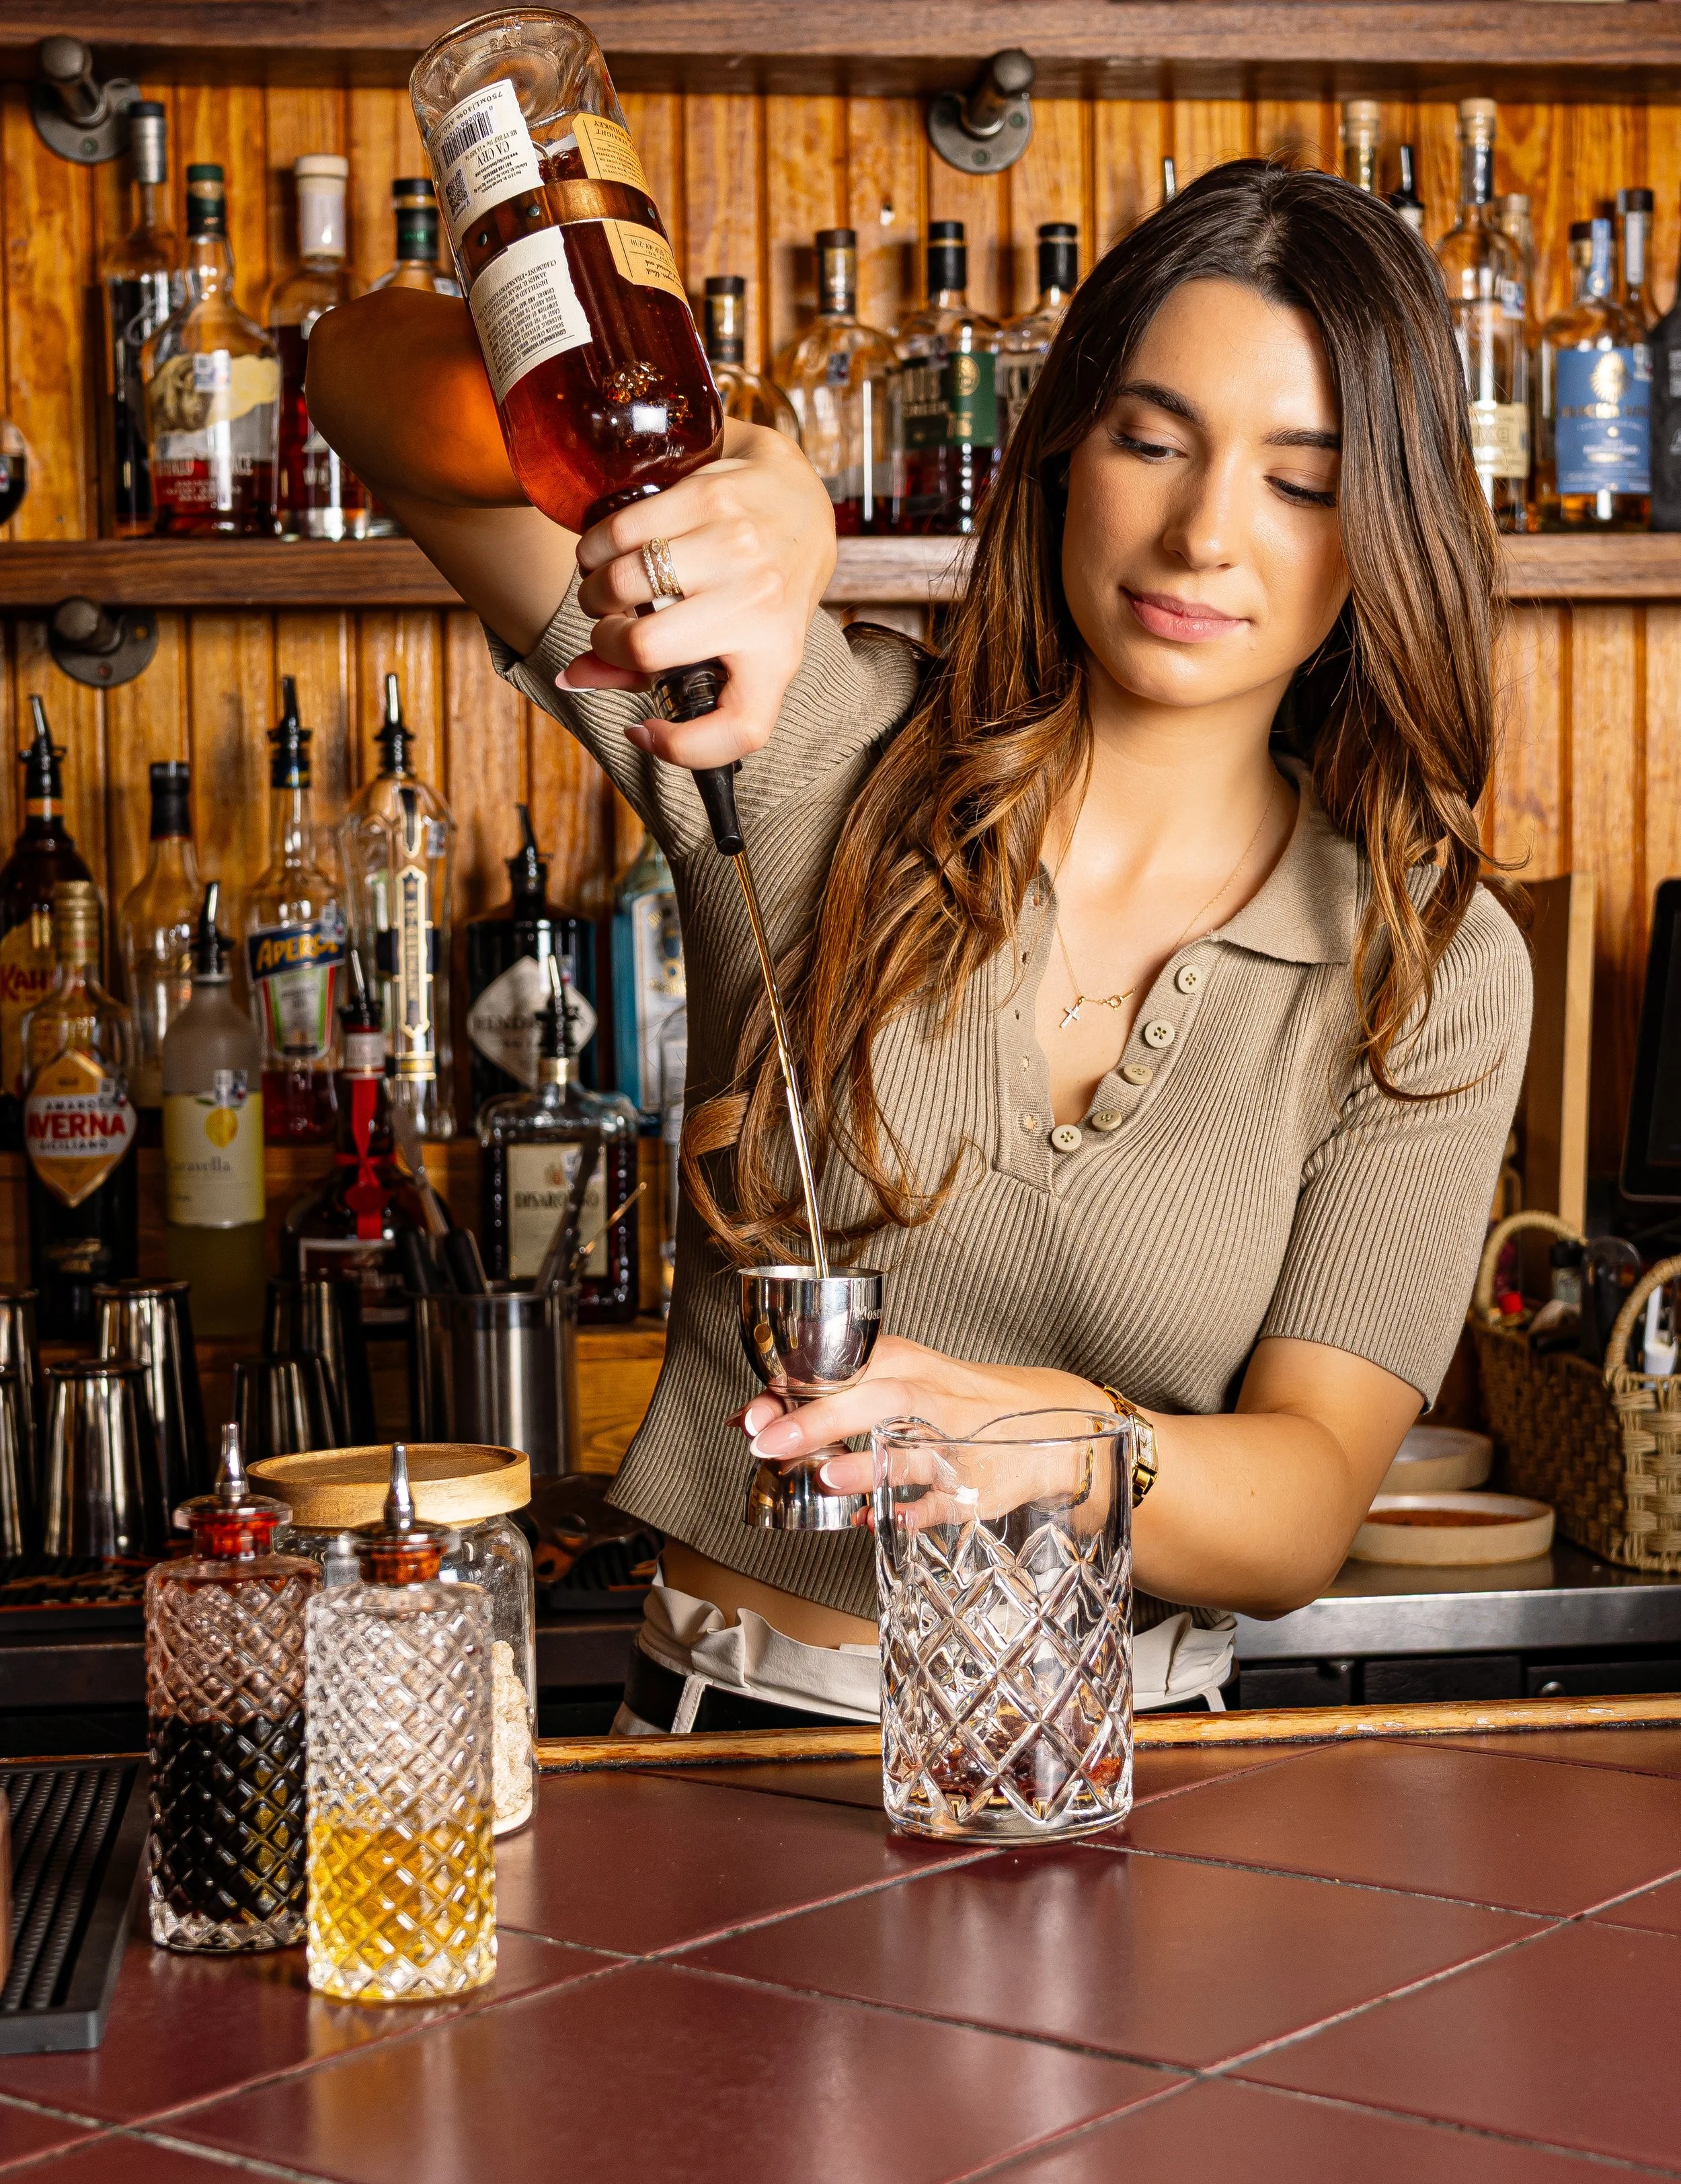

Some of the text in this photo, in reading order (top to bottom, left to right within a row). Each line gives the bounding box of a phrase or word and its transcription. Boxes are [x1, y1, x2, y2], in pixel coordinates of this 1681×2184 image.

[493, 134, 503, 143] REF
[502, 131, 510, 139] VT
[475, 139, 510, 168] CA CRV
[526, 259, 557, 276] CLERMONT
[527, 270, 547, 284] JAMES
[508, 282, 522, 297] BEAM
[518, 278, 548, 298] DISTILLED
[518, 300, 526, 309] MAY
[527, 295, 535, 304] AND
[530, 299, 545, 310] ABILITY
[545, 294, 556, 303] YOUR
[508, 305, 518, 317] CAUSE
[537, 301, 558, 315] SUMPTION
[547, 307, 560, 317] CAUSE
[524, 320, 533, 330] RISK
[541, 314, 562, 328] ALCOHOLIC
[545, 321, 564, 334] SURGEON
[520, 325, 524, 334] OF
[521, 324, 541, 340] BEVERAGES
[538, 328, 566, 346] GOVERNMENT
[28, 1113, 126, 1138] AVERNA
